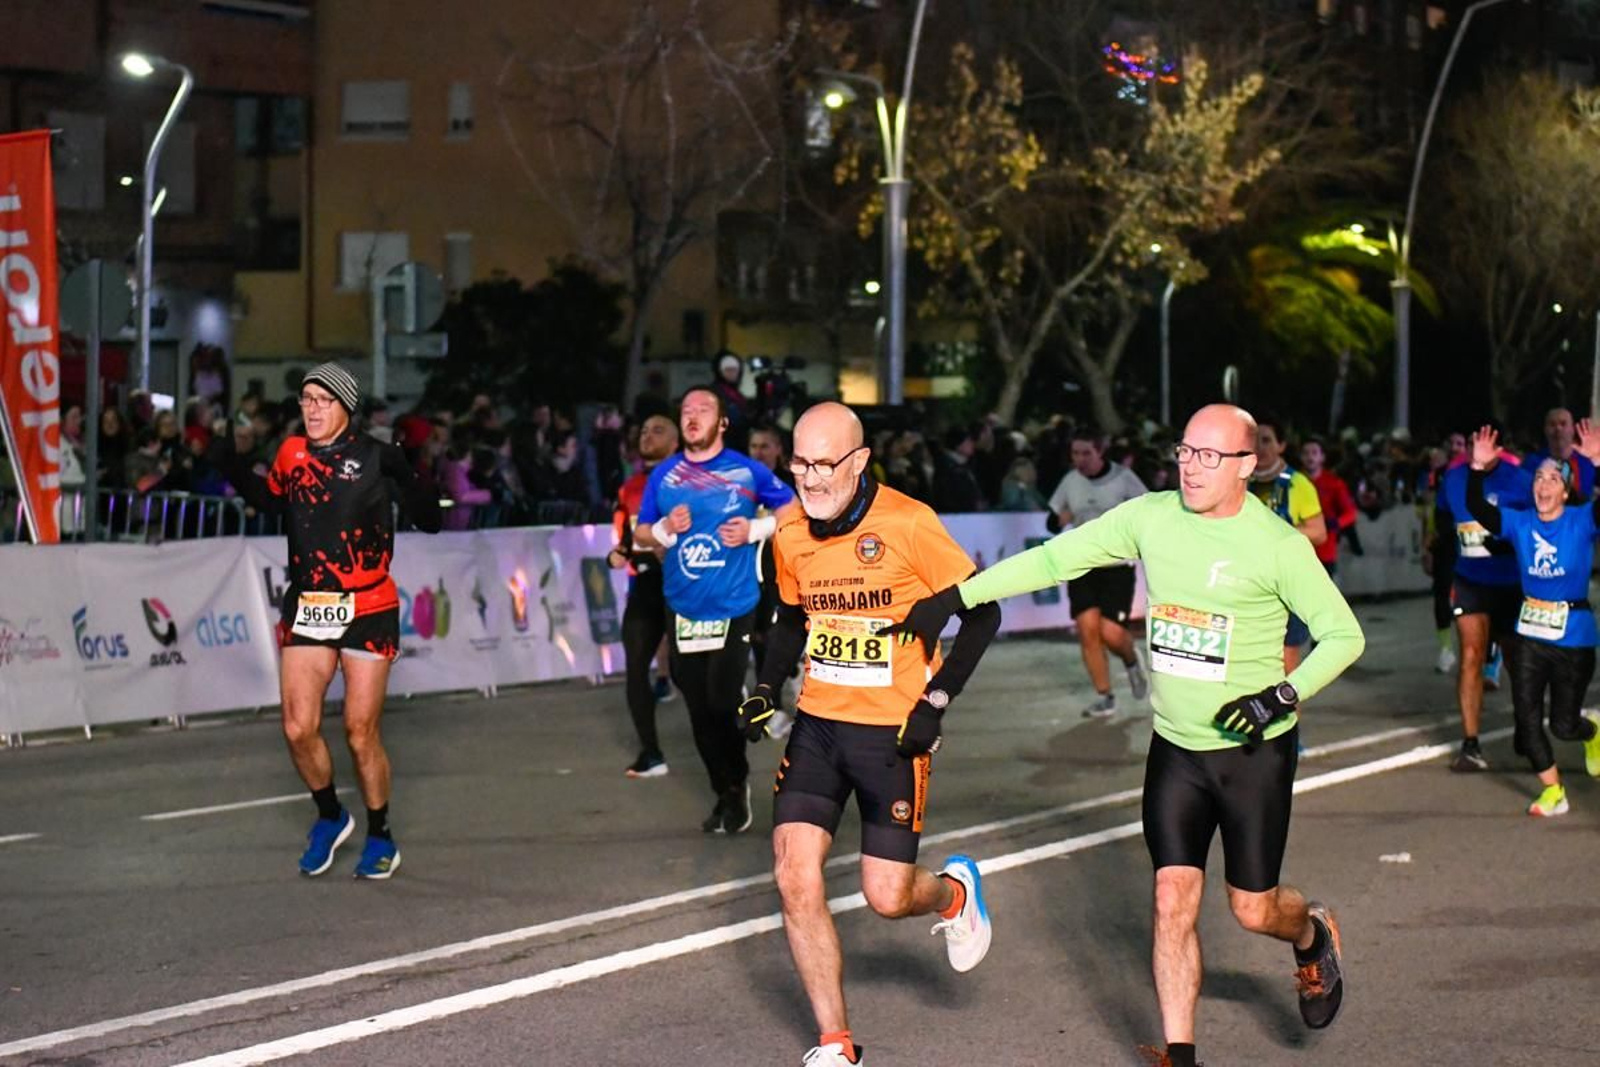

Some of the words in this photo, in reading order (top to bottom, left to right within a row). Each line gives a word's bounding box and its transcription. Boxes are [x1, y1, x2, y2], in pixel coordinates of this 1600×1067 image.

[831, 577, 864, 586] ATLETISMO
[303, 606, 347, 621] 9660
[196, 609, 250, 647] alsa
[680, 620, 725, 638] 2482
[1152, 620, 1221, 657] 2932
[813, 633, 882, 660] 3818
